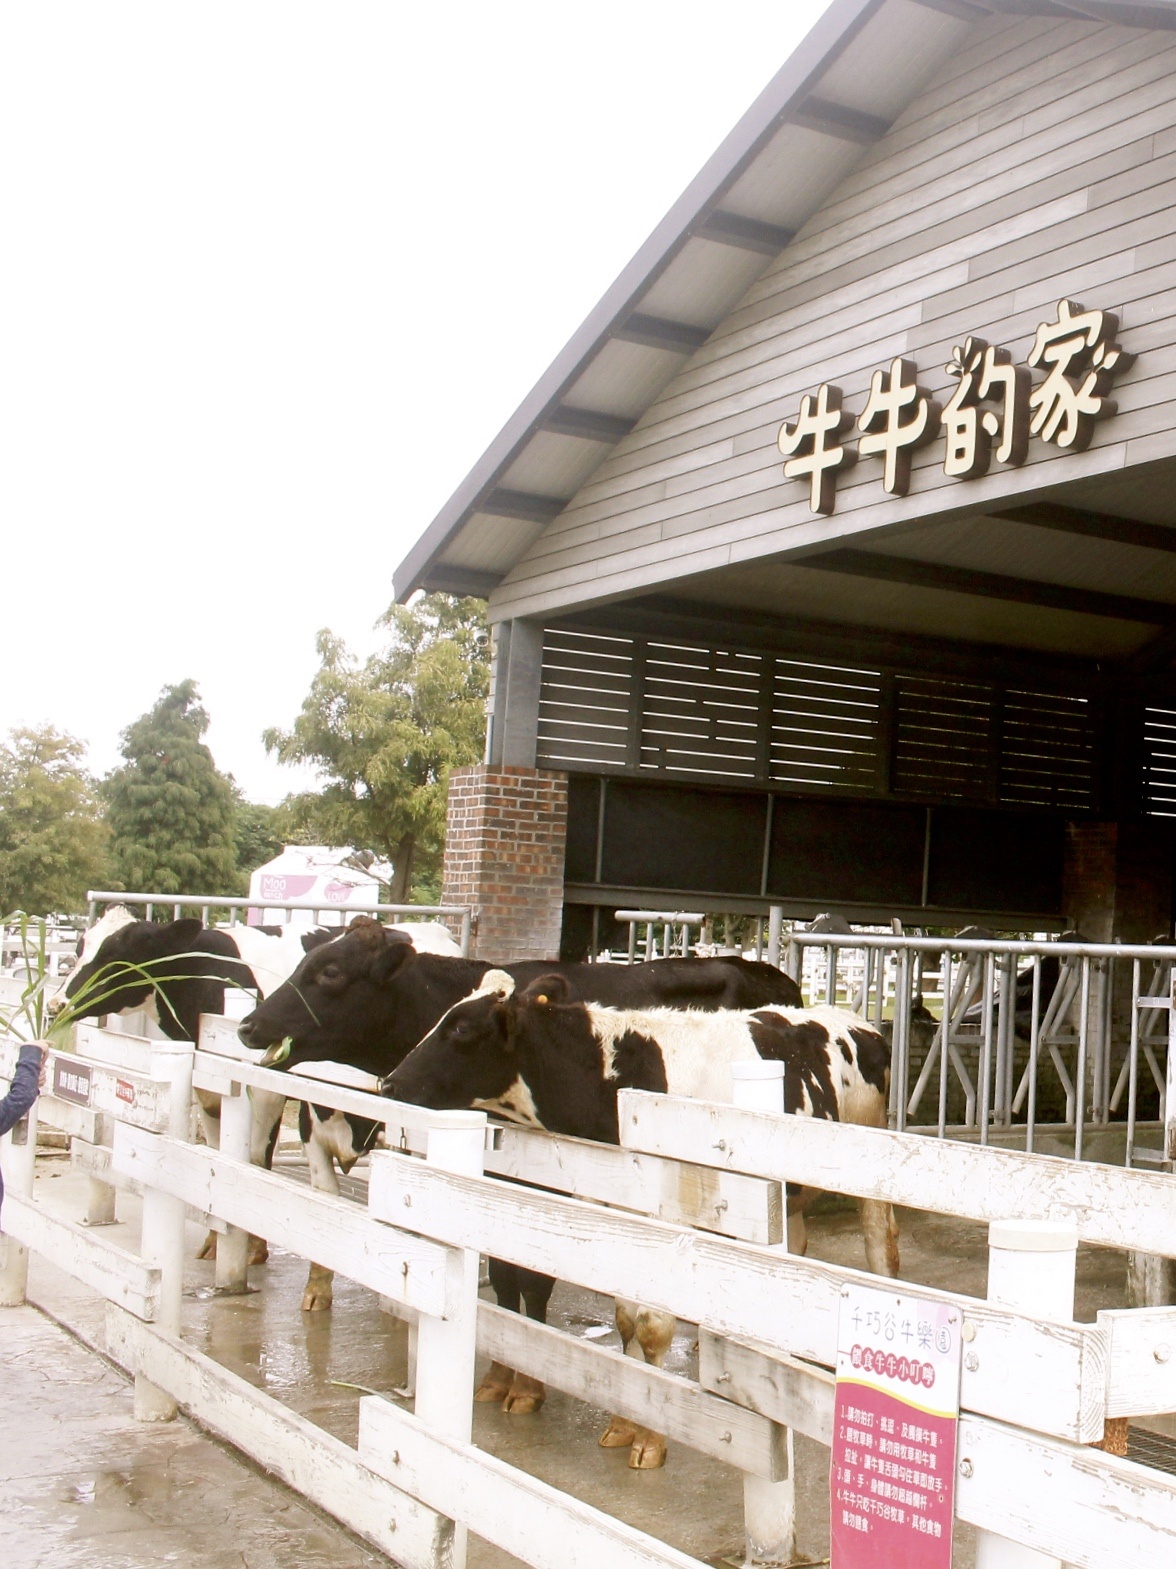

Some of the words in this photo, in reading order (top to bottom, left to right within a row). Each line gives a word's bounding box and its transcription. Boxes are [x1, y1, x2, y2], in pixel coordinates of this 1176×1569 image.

[777, 298, 1126, 515] 牛牛的家
[851, 1306, 951, 1354] 千巧谷牛樂園
[851, 1345, 934, 1387] 餵食牛牛小叮嚀
